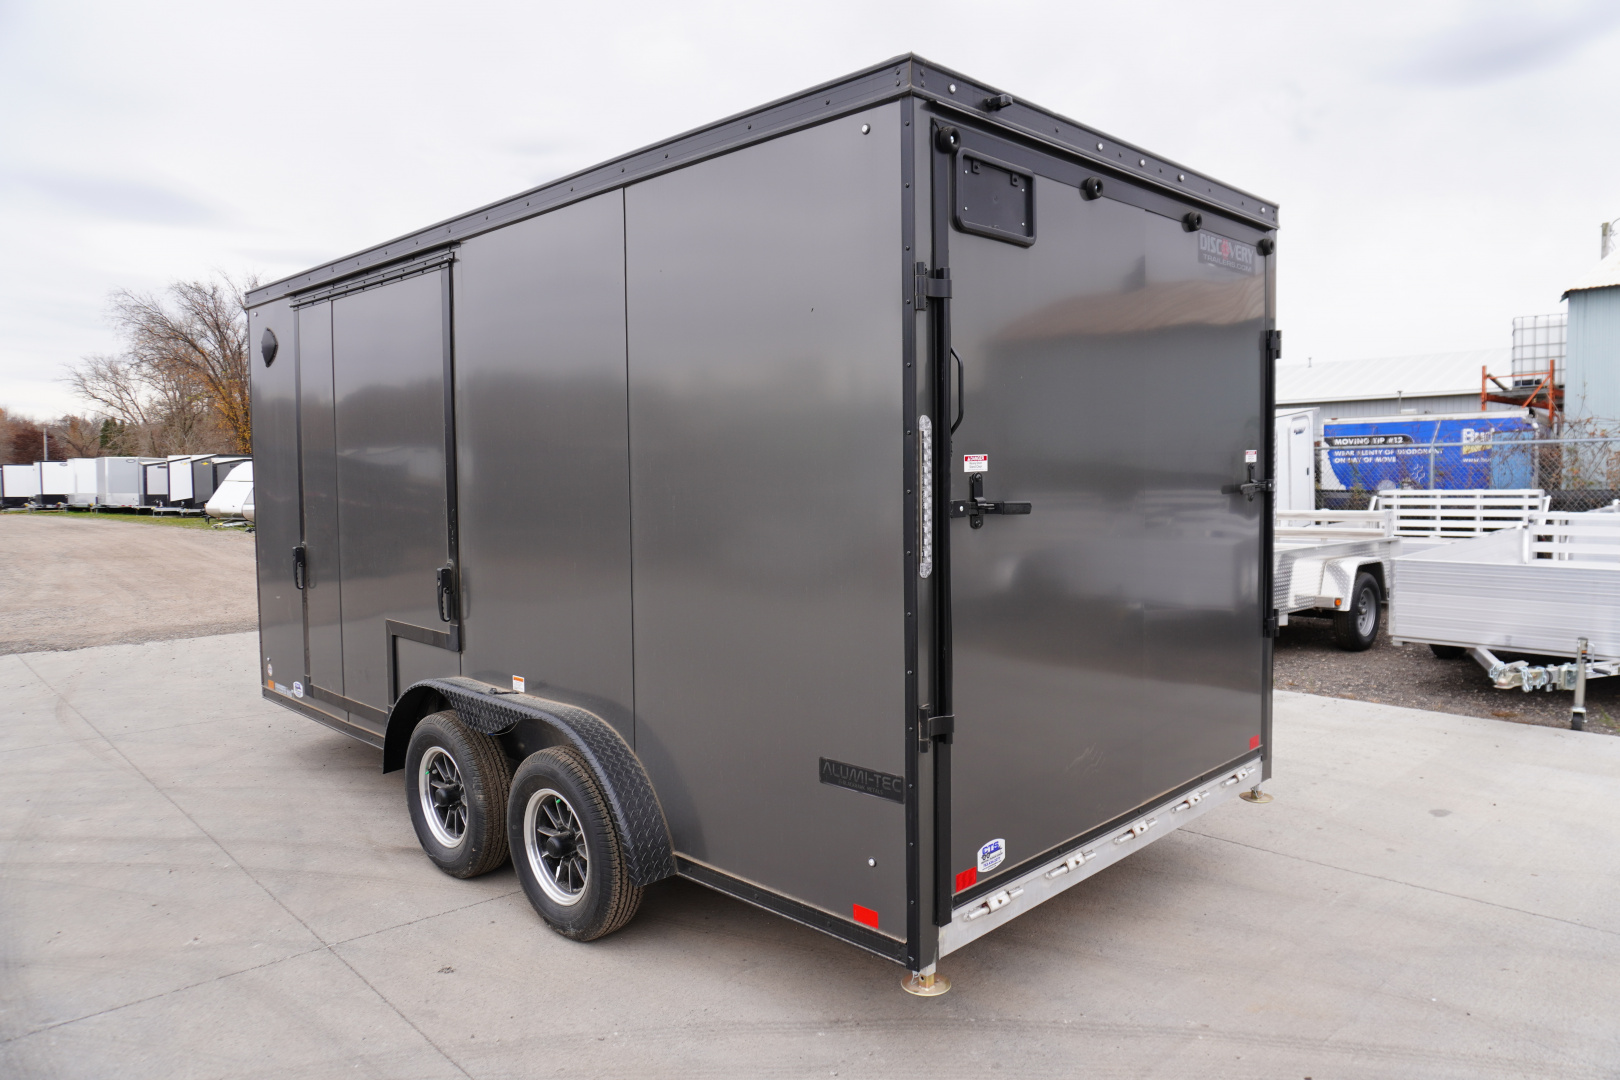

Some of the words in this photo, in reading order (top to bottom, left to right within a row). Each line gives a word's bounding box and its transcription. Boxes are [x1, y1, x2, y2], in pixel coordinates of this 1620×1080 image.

[1199, 233, 1254, 265] DISCOVERY
[1202, 253, 1252, 273] TRAILERS.COM
[1334, 437, 1370, 446] MOVING
[1372, 437, 1386, 445] TIP
[1388, 436, 1404, 444] #12
[822, 761, 903, 793] ALUMI-TEC
[982, 841, 1000, 854] CTS
